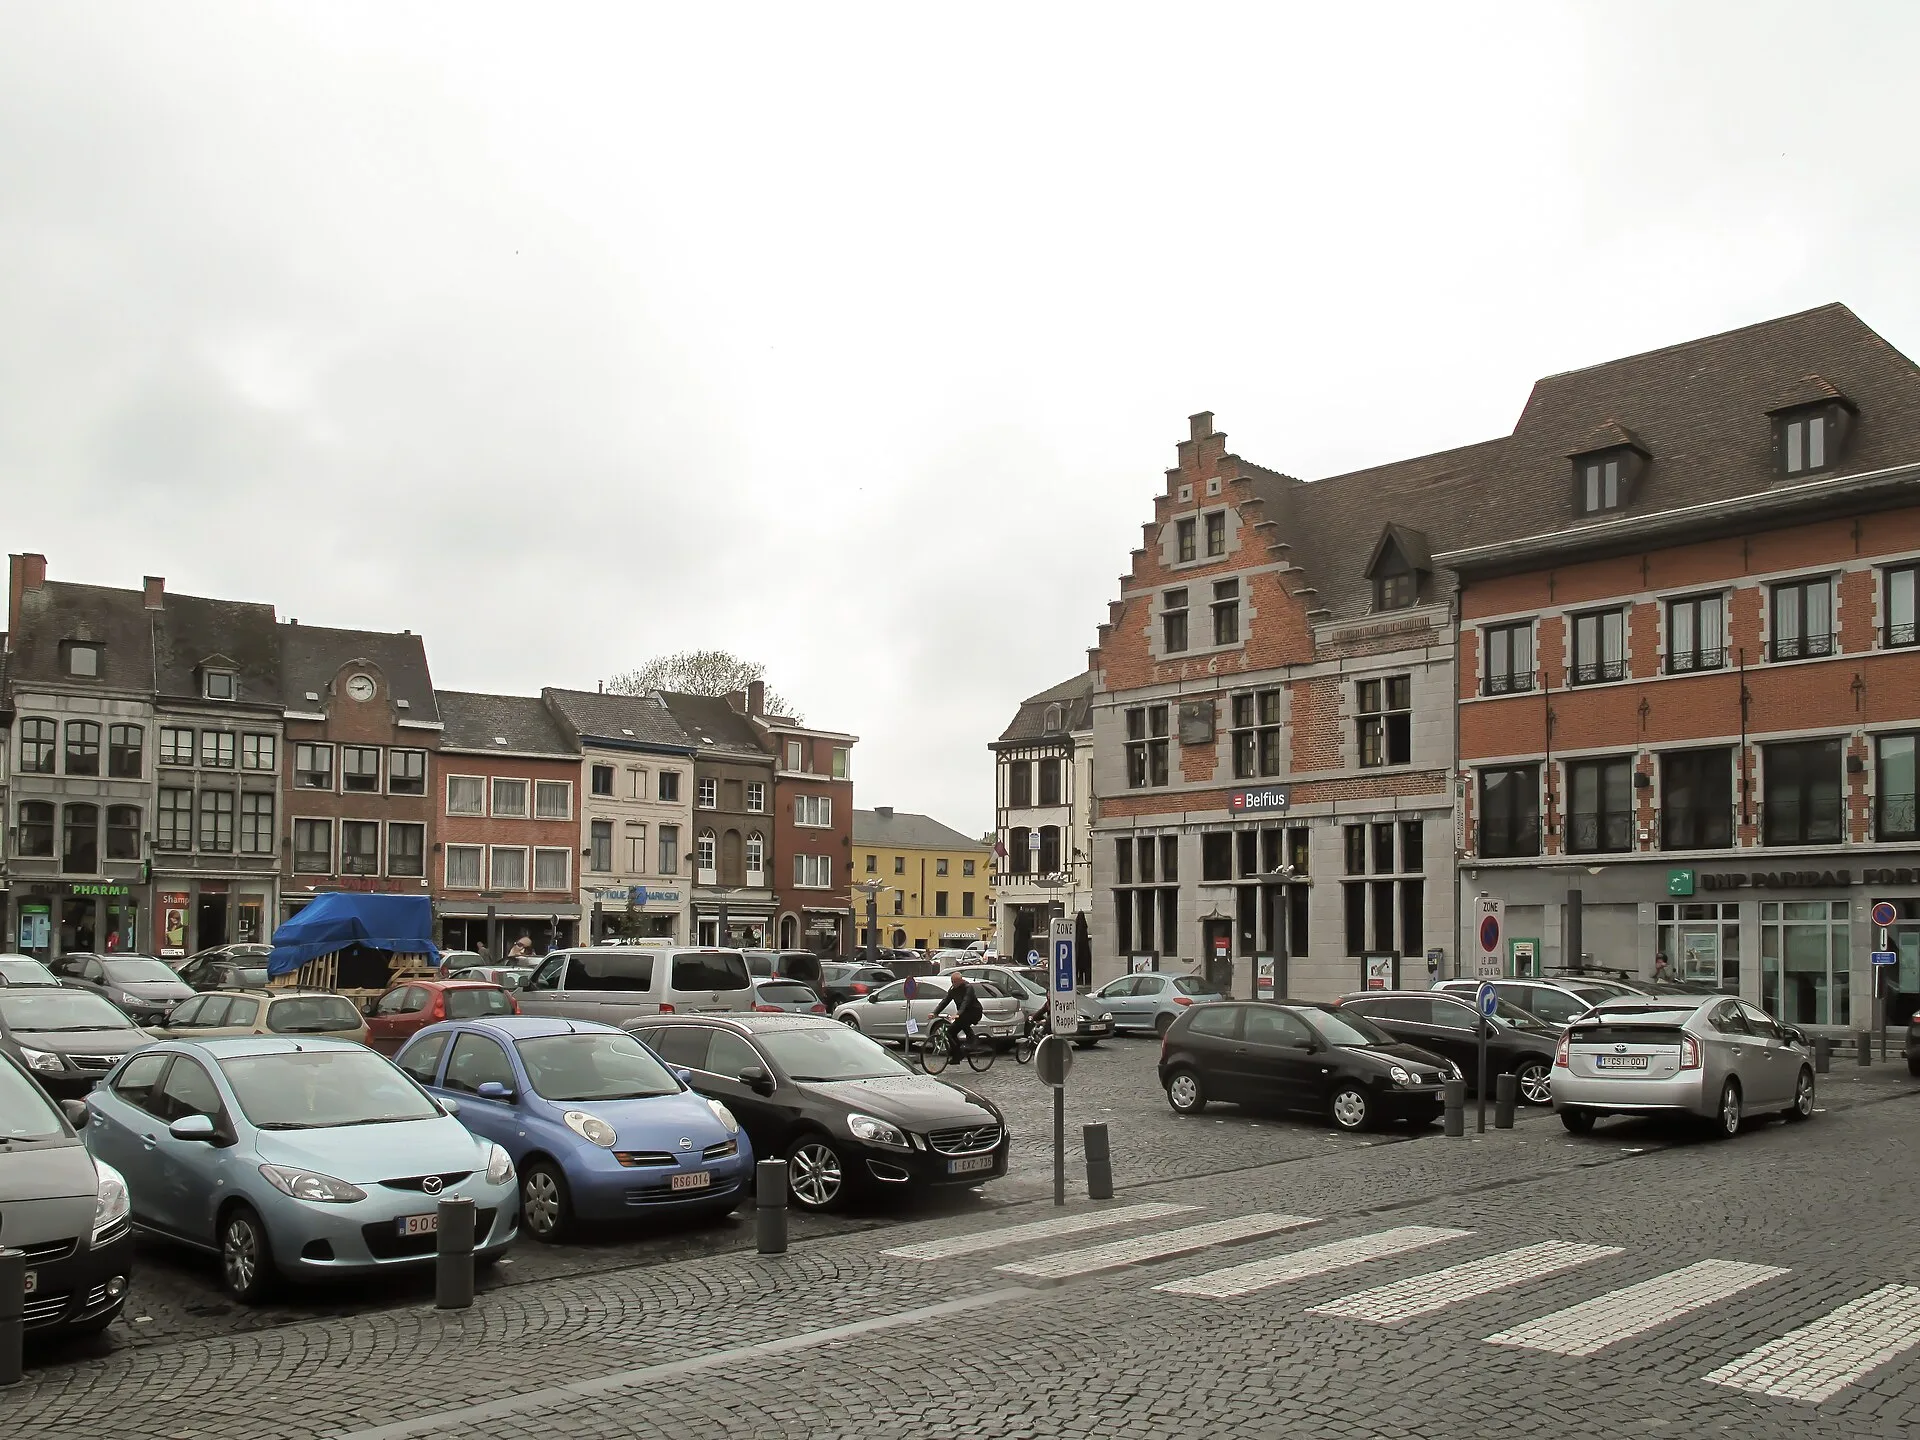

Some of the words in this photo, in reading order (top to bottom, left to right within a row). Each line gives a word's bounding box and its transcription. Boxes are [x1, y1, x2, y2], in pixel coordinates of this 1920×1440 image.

[1246, 792, 1285, 807] Belfius
[73, 885, 129, 895] PHARMA
[1483, 902, 1498, 912] ZONE
[1057, 923, 1072, 934] ZONE
[1060, 943, 1068, 970] P
[1056, 1000, 1075, 1013] Payant
[1056, 1015, 1076, 1028] Rappel
